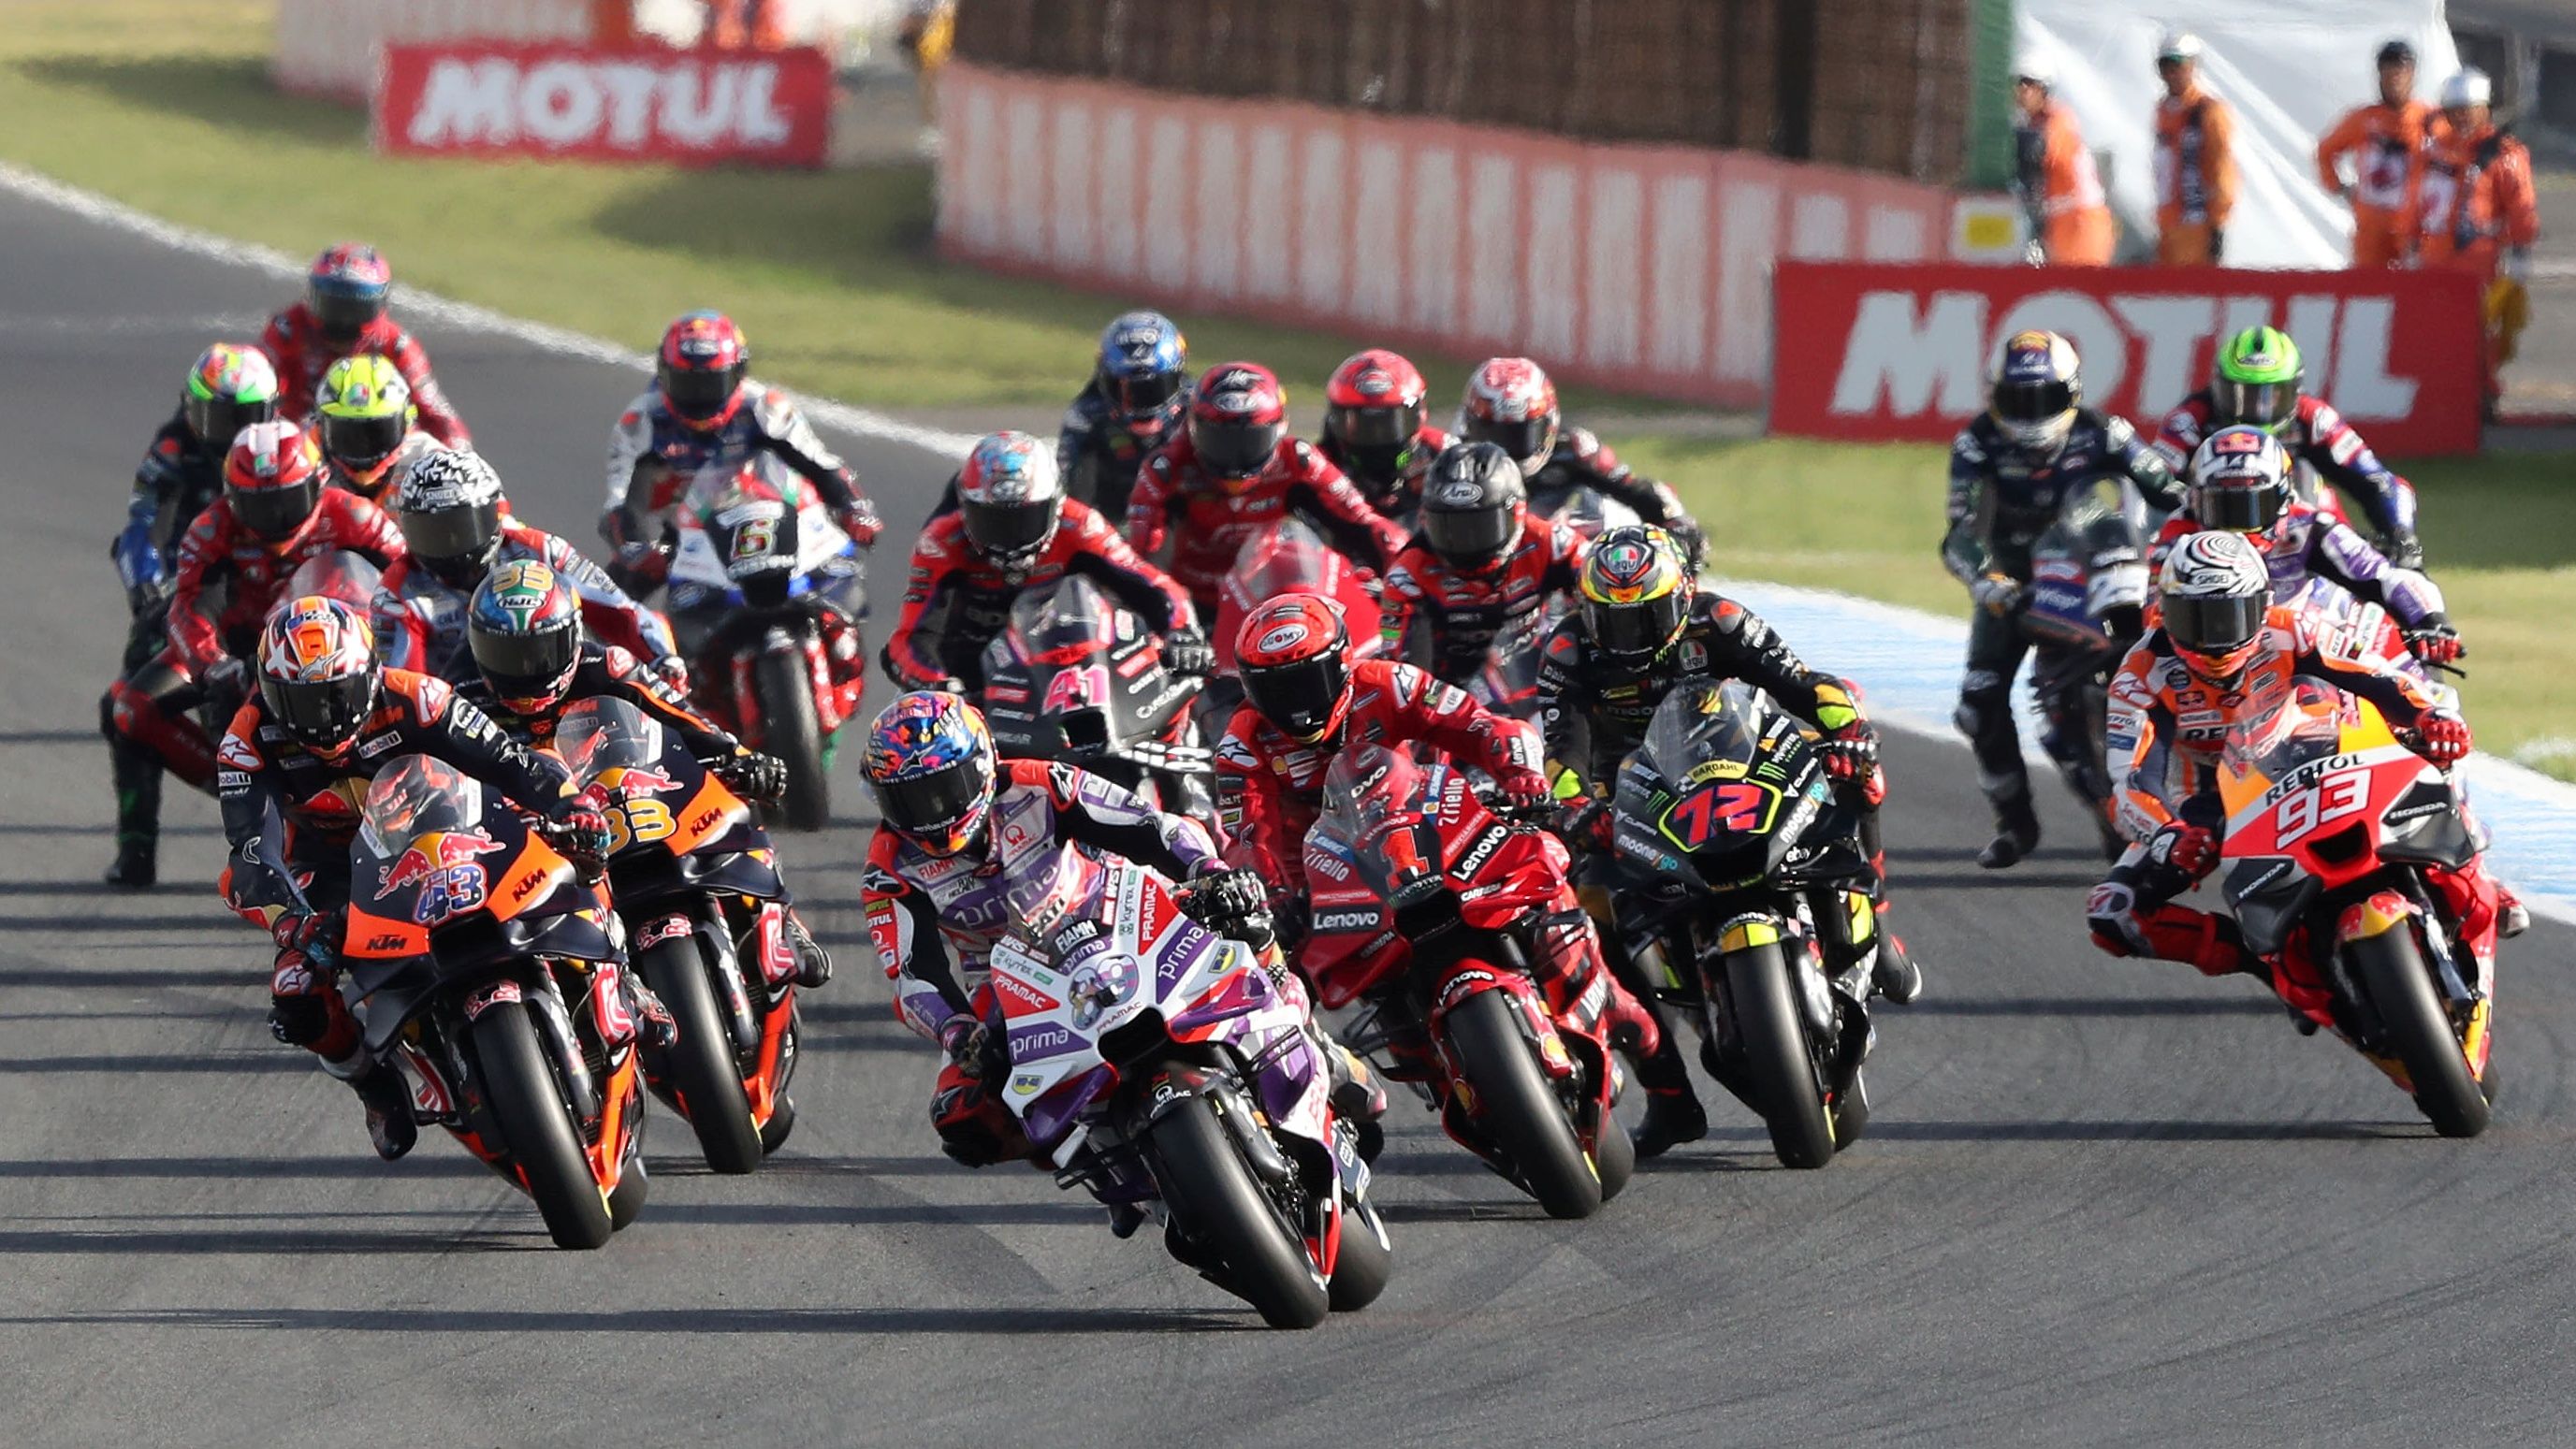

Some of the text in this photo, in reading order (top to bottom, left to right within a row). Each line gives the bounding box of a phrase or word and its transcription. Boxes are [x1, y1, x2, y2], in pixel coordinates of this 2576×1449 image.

[409, 58, 789, 147] MOTUL
[1827, 289, 2420, 424] MOTUL
[493, 563, 554, 592] 33
[2198, 573, 2230, 585] SHOEI
[1043, 665, 1111, 716] 41
[358, 738, 388, 759] Mobil
[218, 774, 239, 786] obil
[1693, 763, 1740, 778] BARDAHL
[2265, 753, 2364, 805] REPSOL
[691, 808, 722, 837] KTM
[1673, 784, 1764, 846] 72
[2277, 768, 2372, 850] 93
[2390, 802, 2448, 819] HONDA
[919, 858, 958, 878] FIAMM
[1452, 826, 1507, 881] Lenovo
[1785, 846, 1811, 862] ebay
[415, 862, 488, 924] 43
[512, 867, 546, 904] KTM
[2238, 862, 2286, 899] HONDA
[1142, 884, 1157, 941] PRAMAC
[1313, 912, 1379, 930] Lenovo
[366, 935, 407, 950] KTM
[1056, 920, 1097, 953] FIAMM
[1158, 926, 1204, 980] prima
[1064, 939, 1106, 972] prima
[995, 975, 1046, 1009] PRAMAC
[1011, 1029, 1069, 1061] prima
